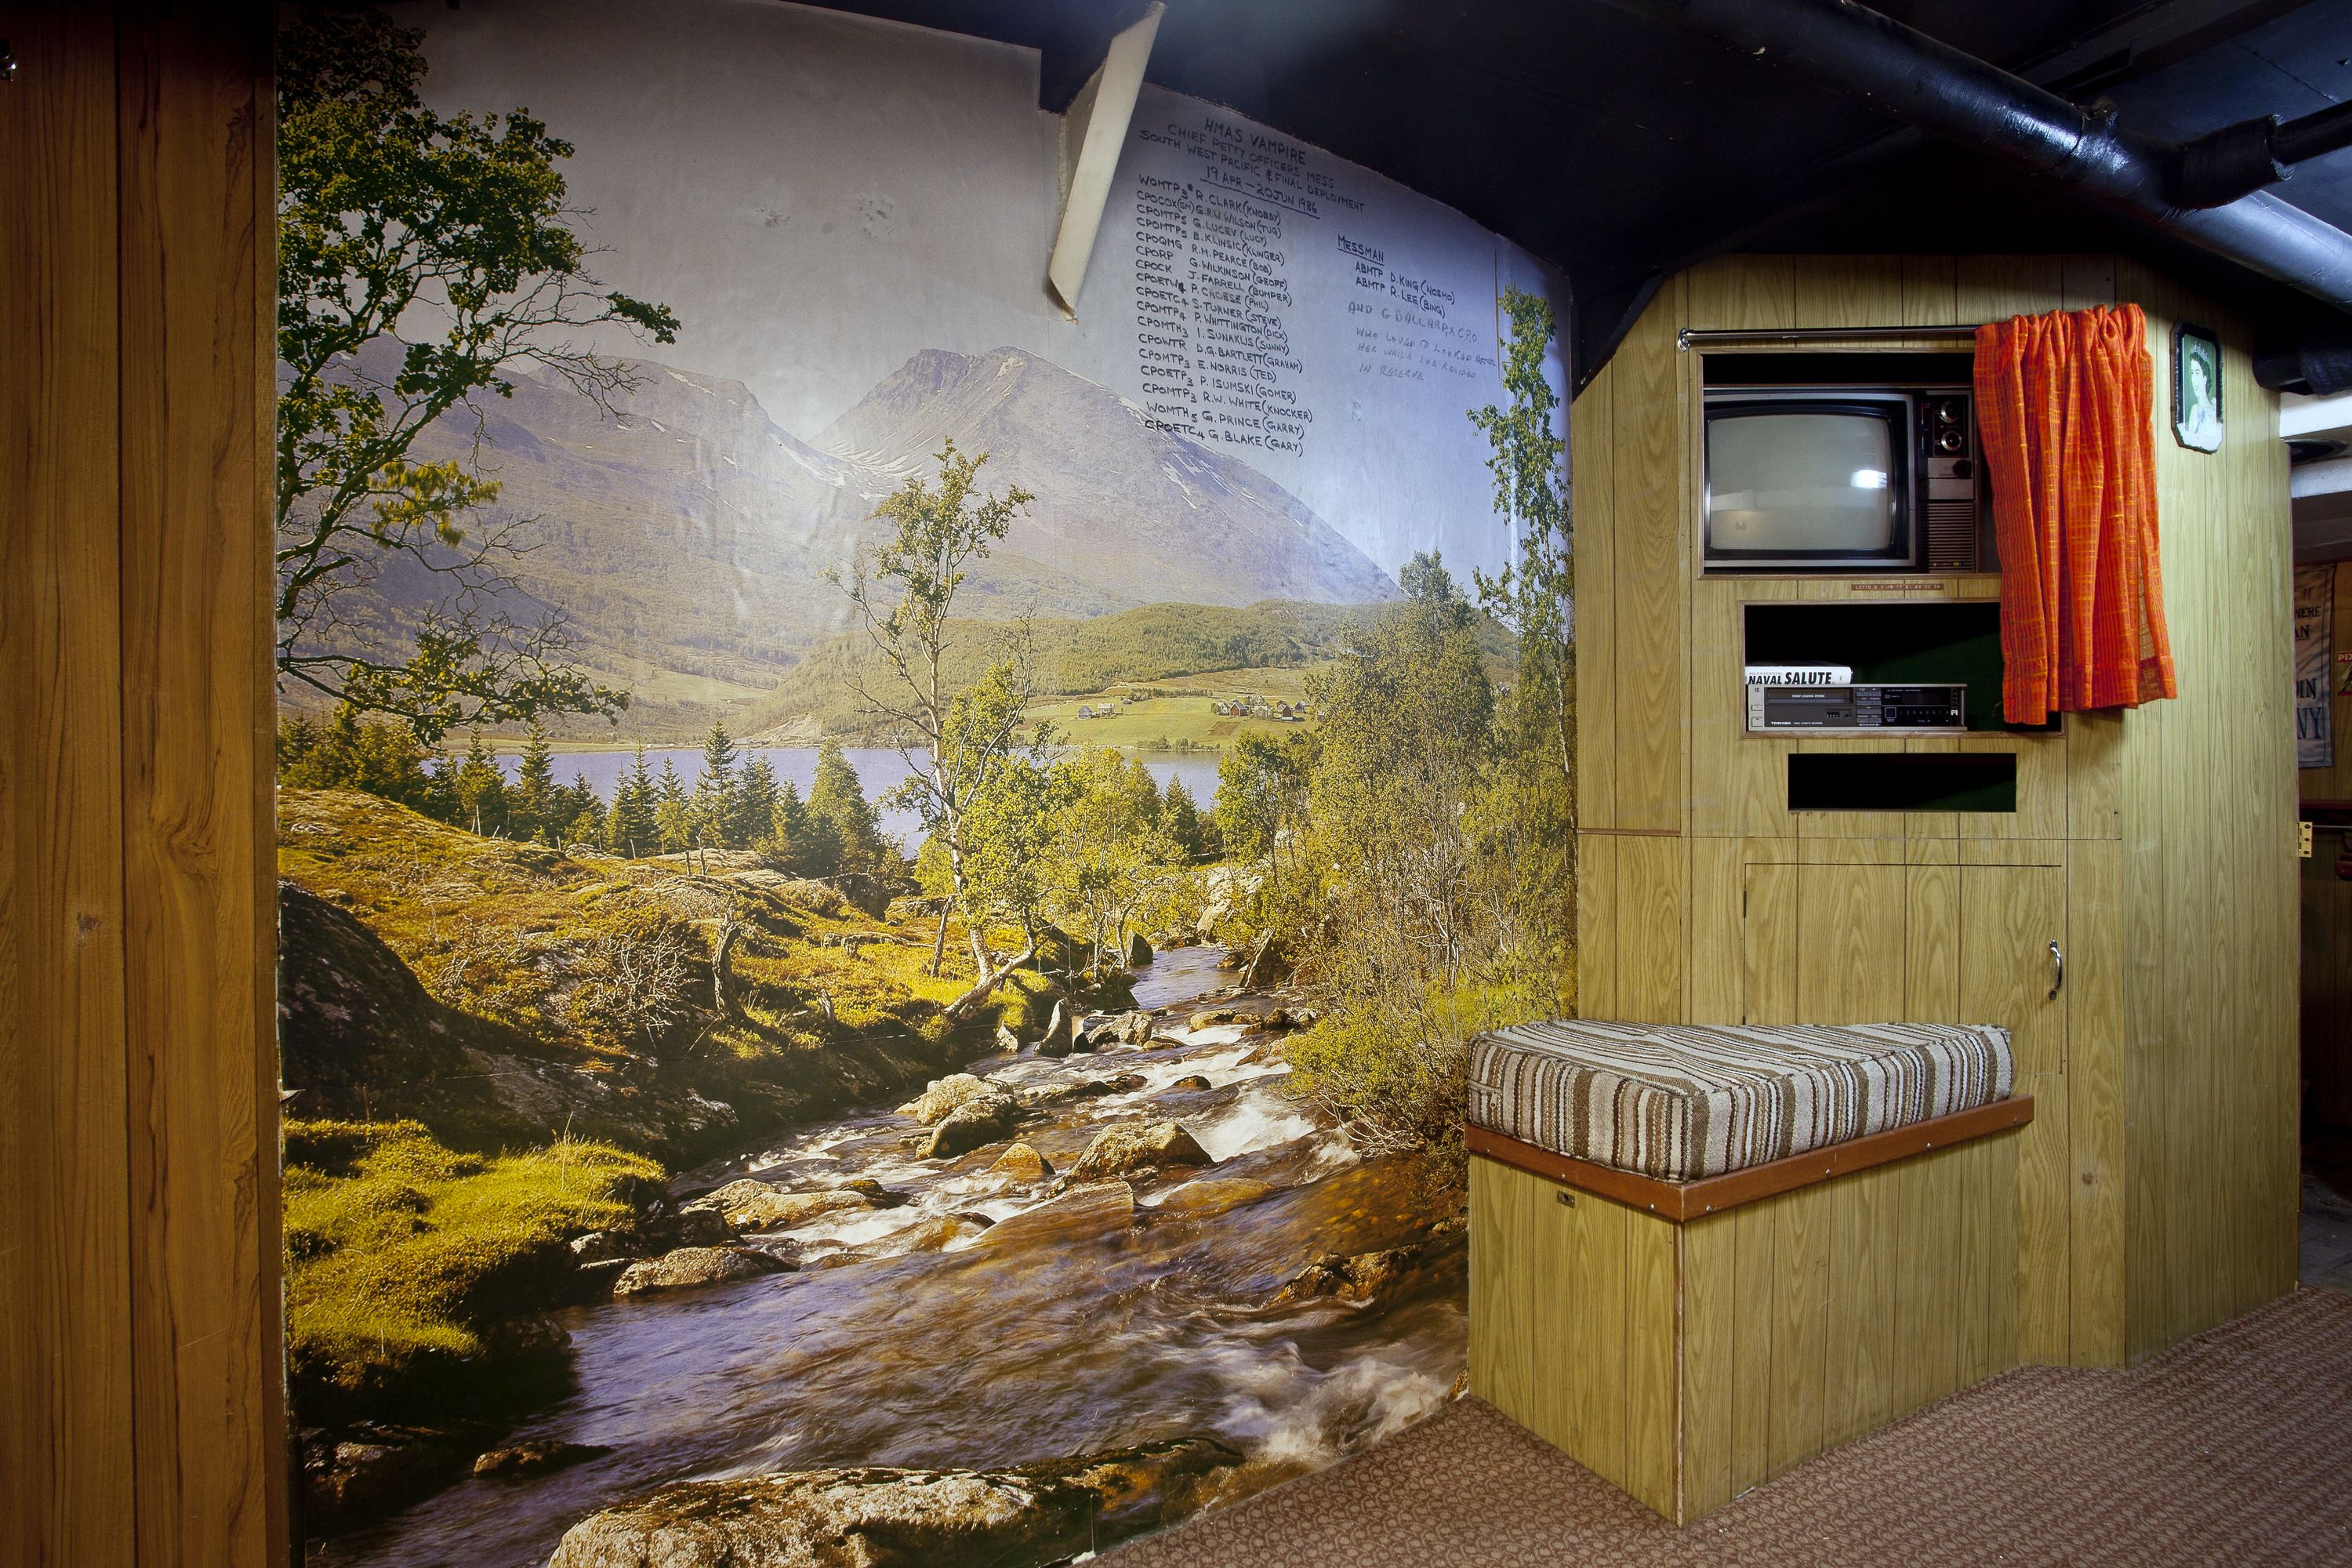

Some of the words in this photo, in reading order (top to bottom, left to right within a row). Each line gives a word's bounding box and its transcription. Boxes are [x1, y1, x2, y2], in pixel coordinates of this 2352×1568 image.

[1205, 118, 1243, 142] HMAS
[1250, 133, 1306, 165] VAMPIRE
[1167, 125, 1207, 143] CHIEF
[1213, 138, 1245, 158] PETTY
[1249, 153, 1300, 177] OFFICERS
[1307, 172, 1334, 188] MESS
[1139, 129, 1181, 149] SOUTH
[1187, 144, 1217, 161] WEST
[1221, 154, 1261, 177] PACIFIC
[1275, 173, 1302, 190] FINAL
[1307, 185, 1365, 212] DEPLOYMENT
[1207, 165, 1218, 180] 19
[1223, 172, 1243, 189] APR
[1298, 198, 1317, 213] 1986
[1136, 231, 1182, 249] CPOQMG
[1136, 245, 1173, 260] CPORP
[1135, 260, 1172, 274] CPOCK
[1356, 261, 1384, 278] ABMTP
[1356, 276, 1385, 292] ABMTP
[1348, 301, 1372, 314] AND
[1138, 333, 1187, 350] CPOWTR
[1250, 365, 1276, 383] (TED)
[1748, 676, 1782, 684] NAVAL
[1784, 672, 1832, 684] SALUTE
